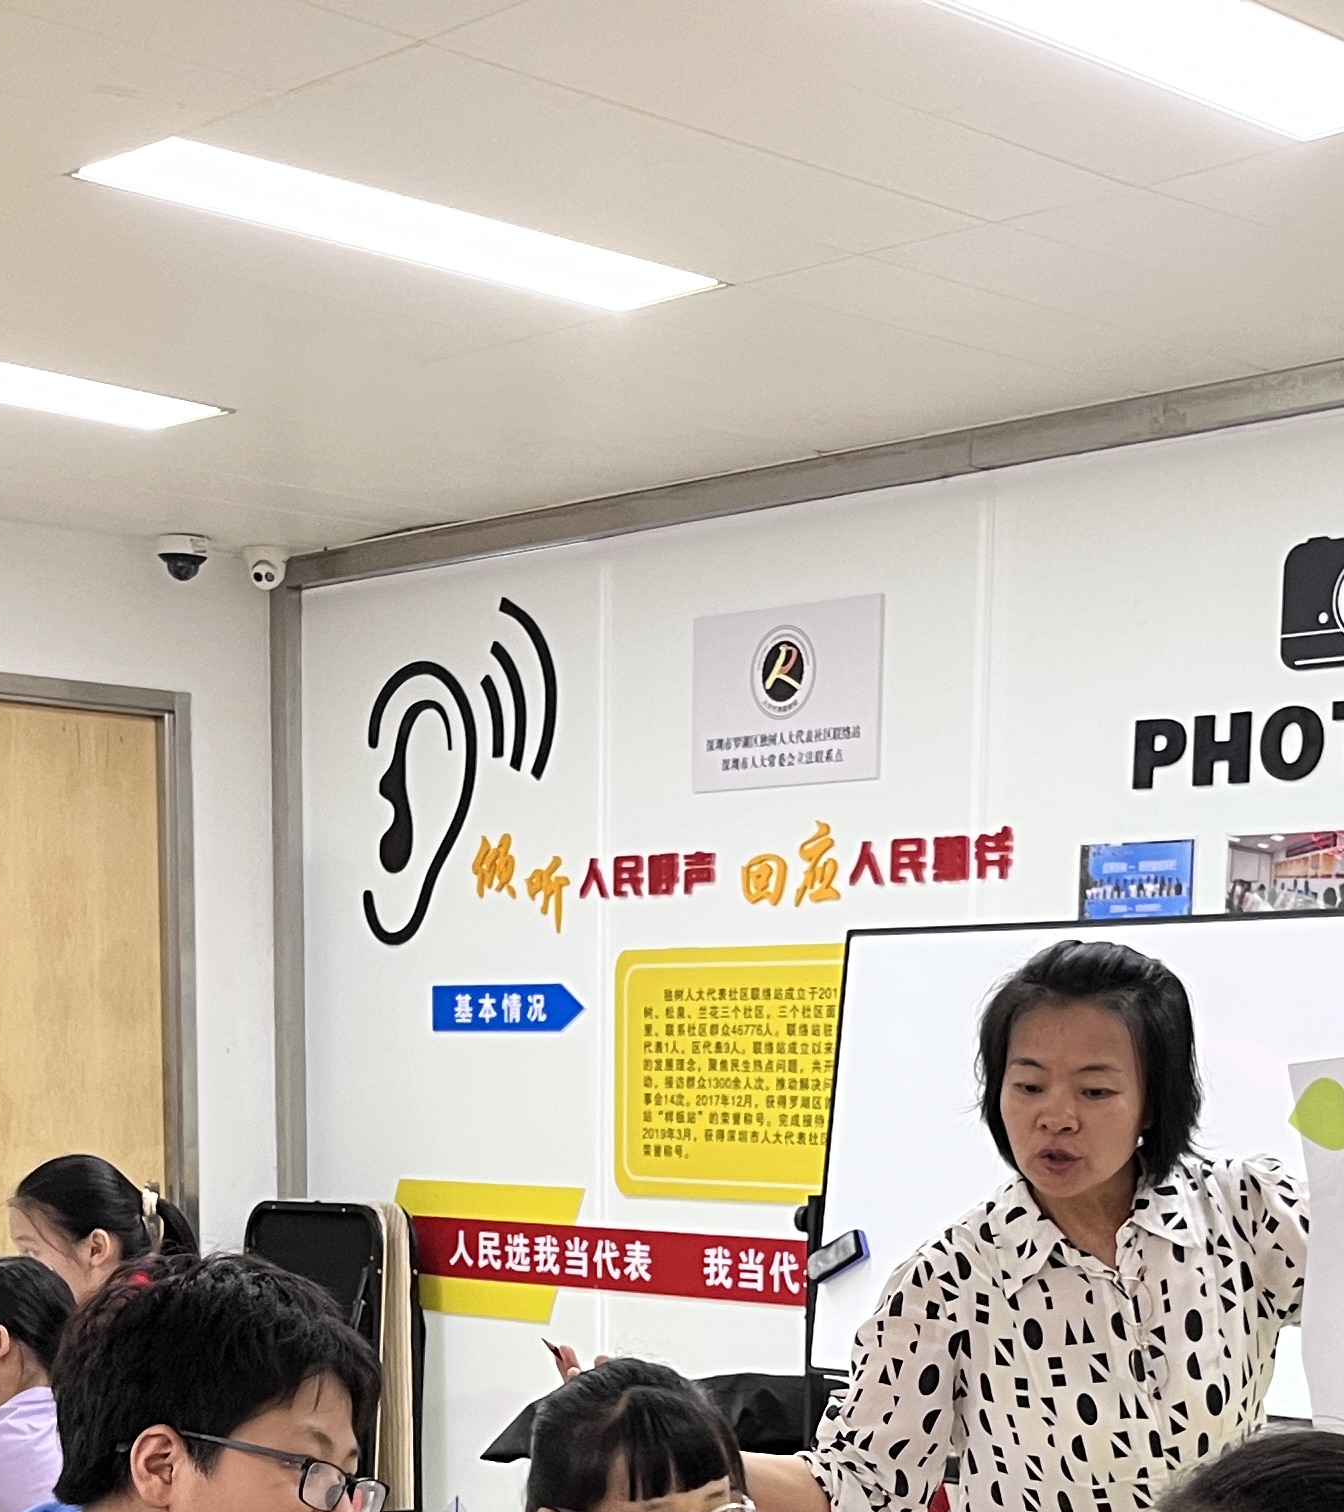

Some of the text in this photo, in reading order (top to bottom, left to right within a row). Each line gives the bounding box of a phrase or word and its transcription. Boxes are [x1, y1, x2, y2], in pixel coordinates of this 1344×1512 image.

[471, 832, 717, 934] 倾听人民呼声
[453, 993, 548, 1024] 基本情况
[448, 1229, 808, 1295] 人民选我当代表 我当代
